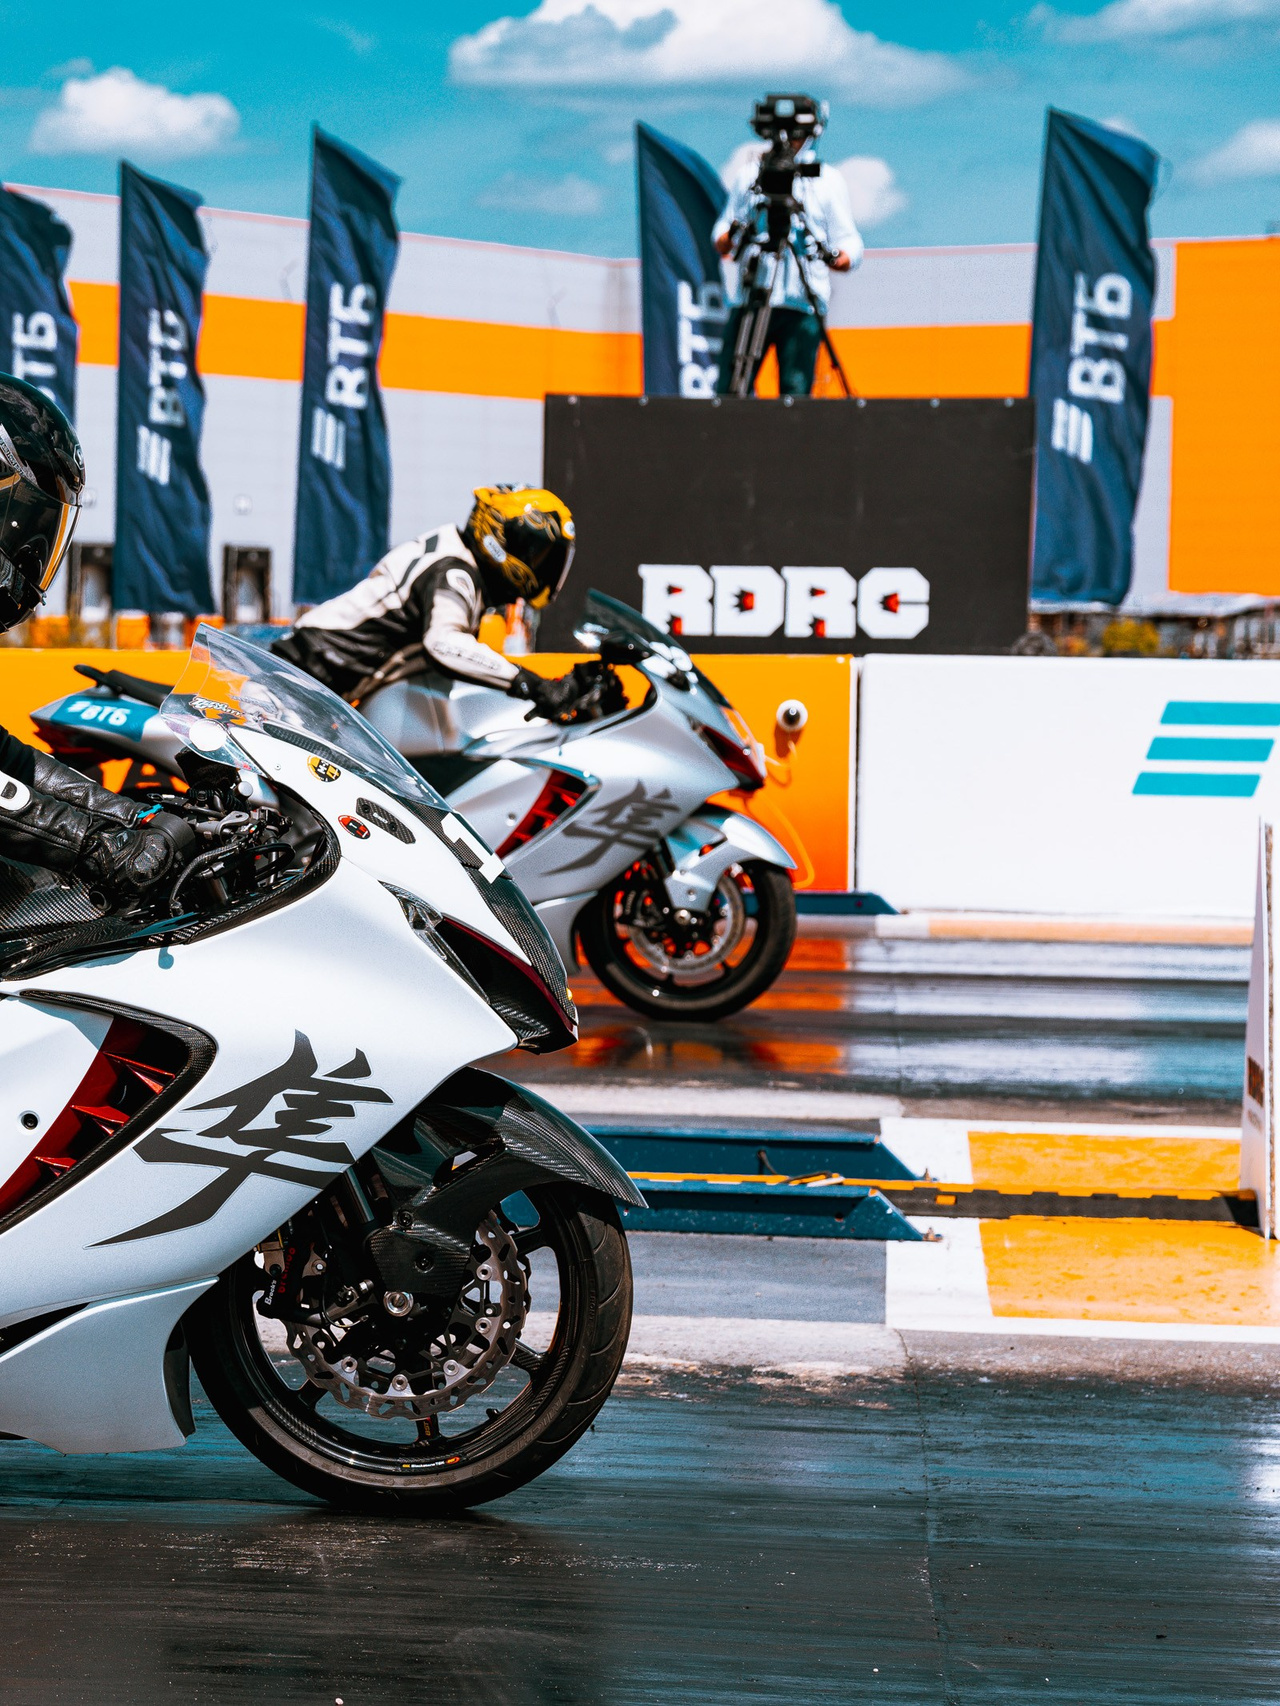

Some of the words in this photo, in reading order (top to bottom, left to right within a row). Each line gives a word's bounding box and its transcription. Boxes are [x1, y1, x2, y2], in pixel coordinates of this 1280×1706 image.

[12, 311, 58, 401] ТБ
[1068, 271, 1132, 406] ВТБ
[638, 564, 930, 640] RDRC
[264, 1279, 277, 1306] Brock's
